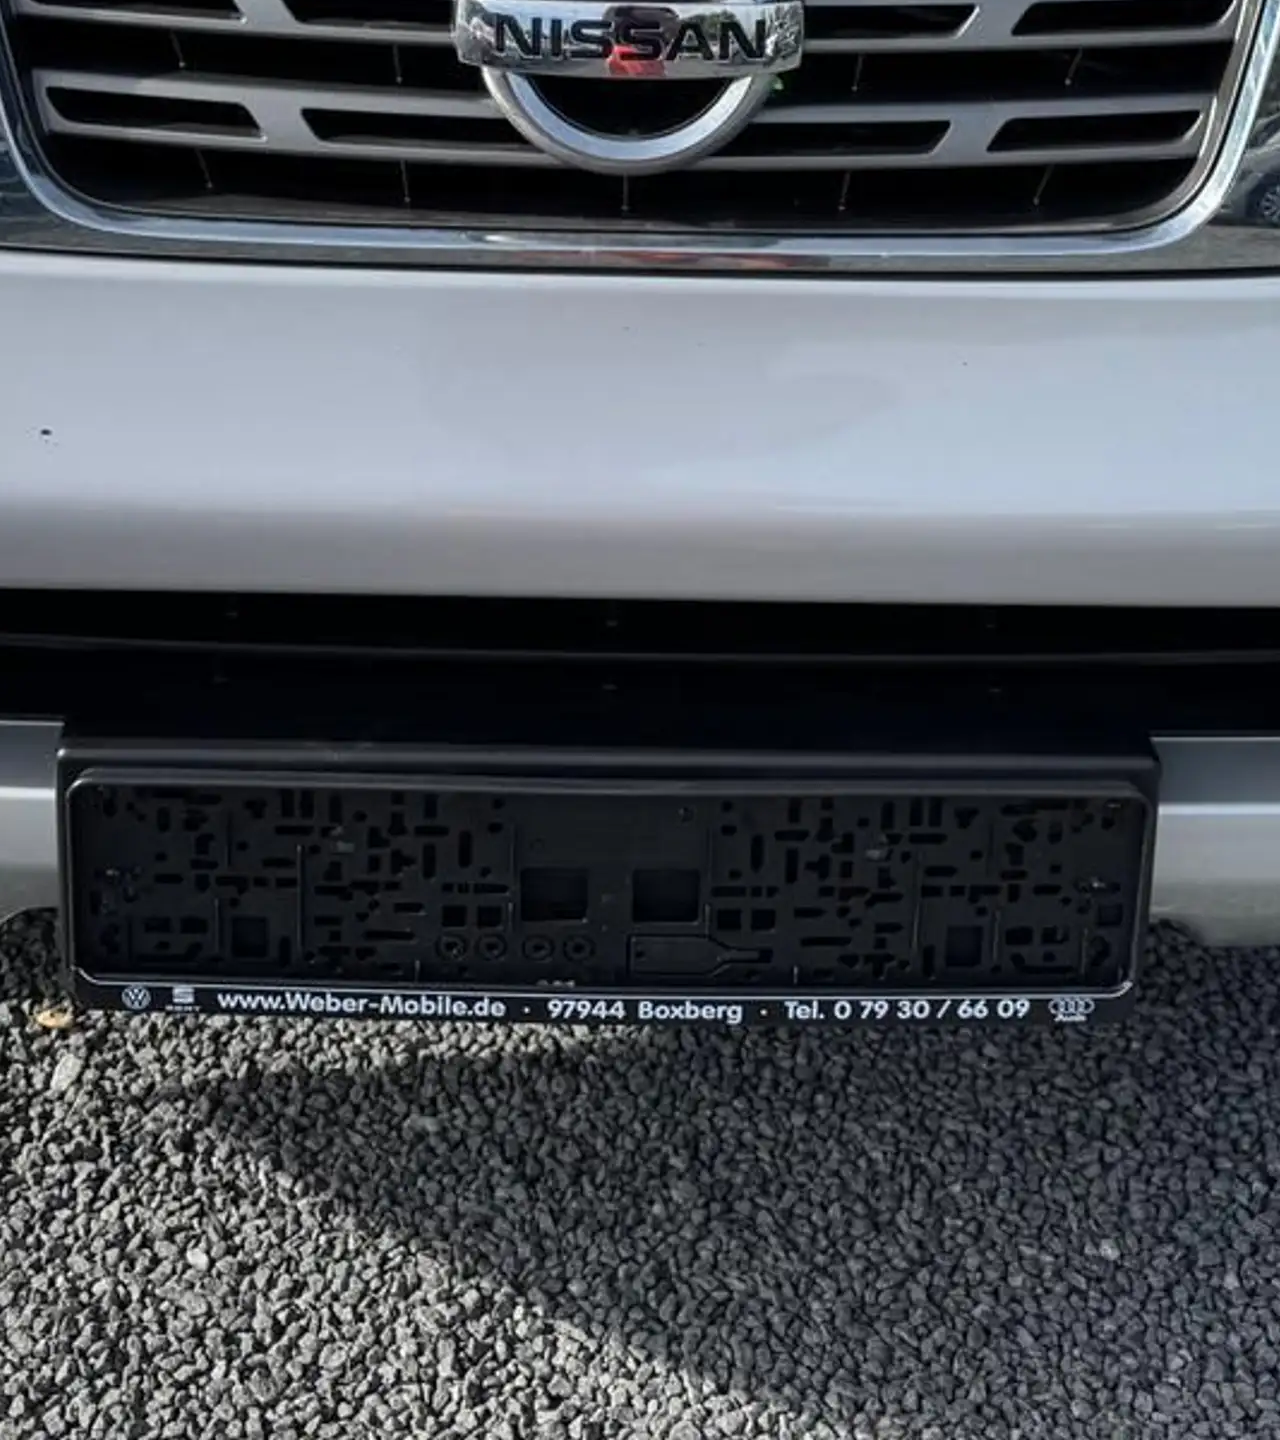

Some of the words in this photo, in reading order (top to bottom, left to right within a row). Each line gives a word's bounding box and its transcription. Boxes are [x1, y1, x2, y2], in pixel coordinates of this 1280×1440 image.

[494, 13, 766, 60] NISSAN
[217, 990, 506, 1017] www.Weber-Mobile.de
[547, 999, 626, 1020] 97944
[638, 1000, 743, 1025] Boxberg
[784, 1000, 825, 1020] Tel.
[833, 1000, 852, 1020] 0
[860, 1000, 889, 1020] 79
[896, 1000, 930, 1020] 30
[957, 999, 989, 1019] 66
[997, 999, 1030, 1019] 09
